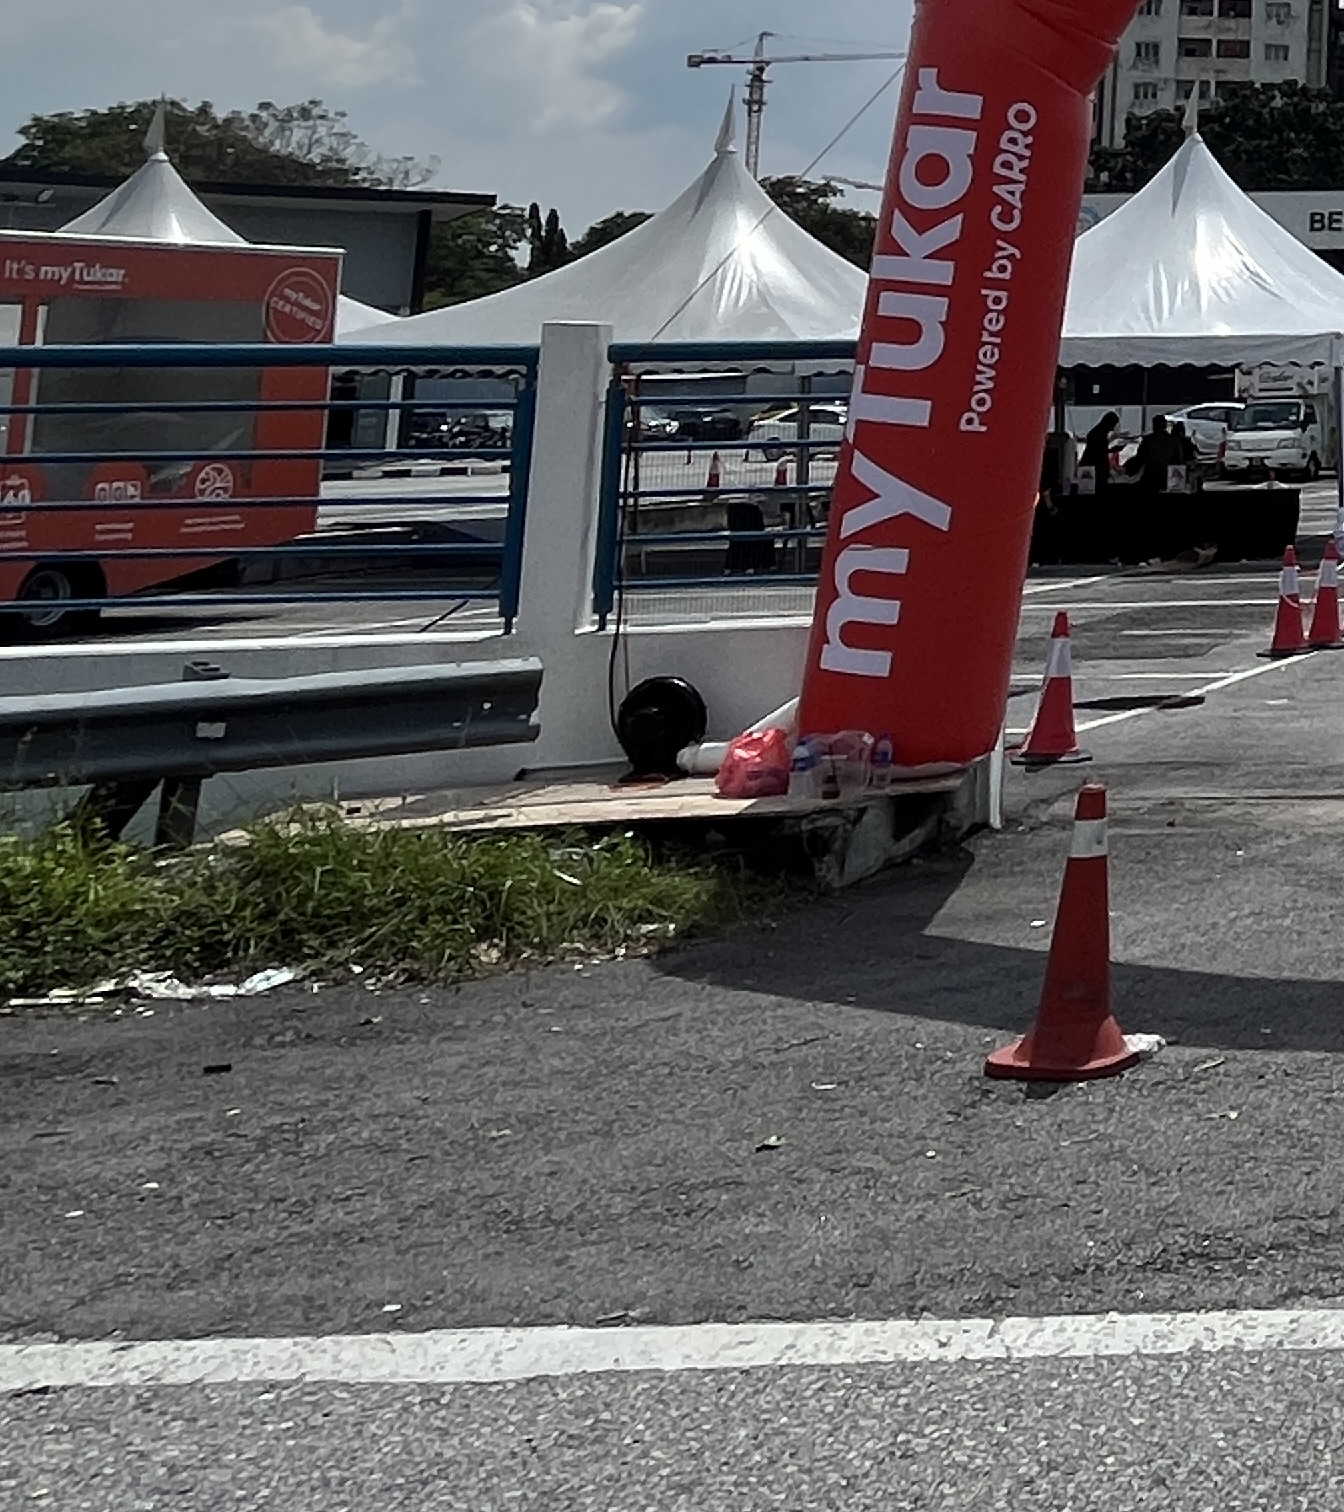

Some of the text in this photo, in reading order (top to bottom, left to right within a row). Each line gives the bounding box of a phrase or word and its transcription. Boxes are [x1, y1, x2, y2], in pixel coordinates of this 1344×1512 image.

[4, 258, 36, 280] It's
[819, 66, 985, 679] myTukar
[959, 102, 1038, 433] Powered by CARRO
